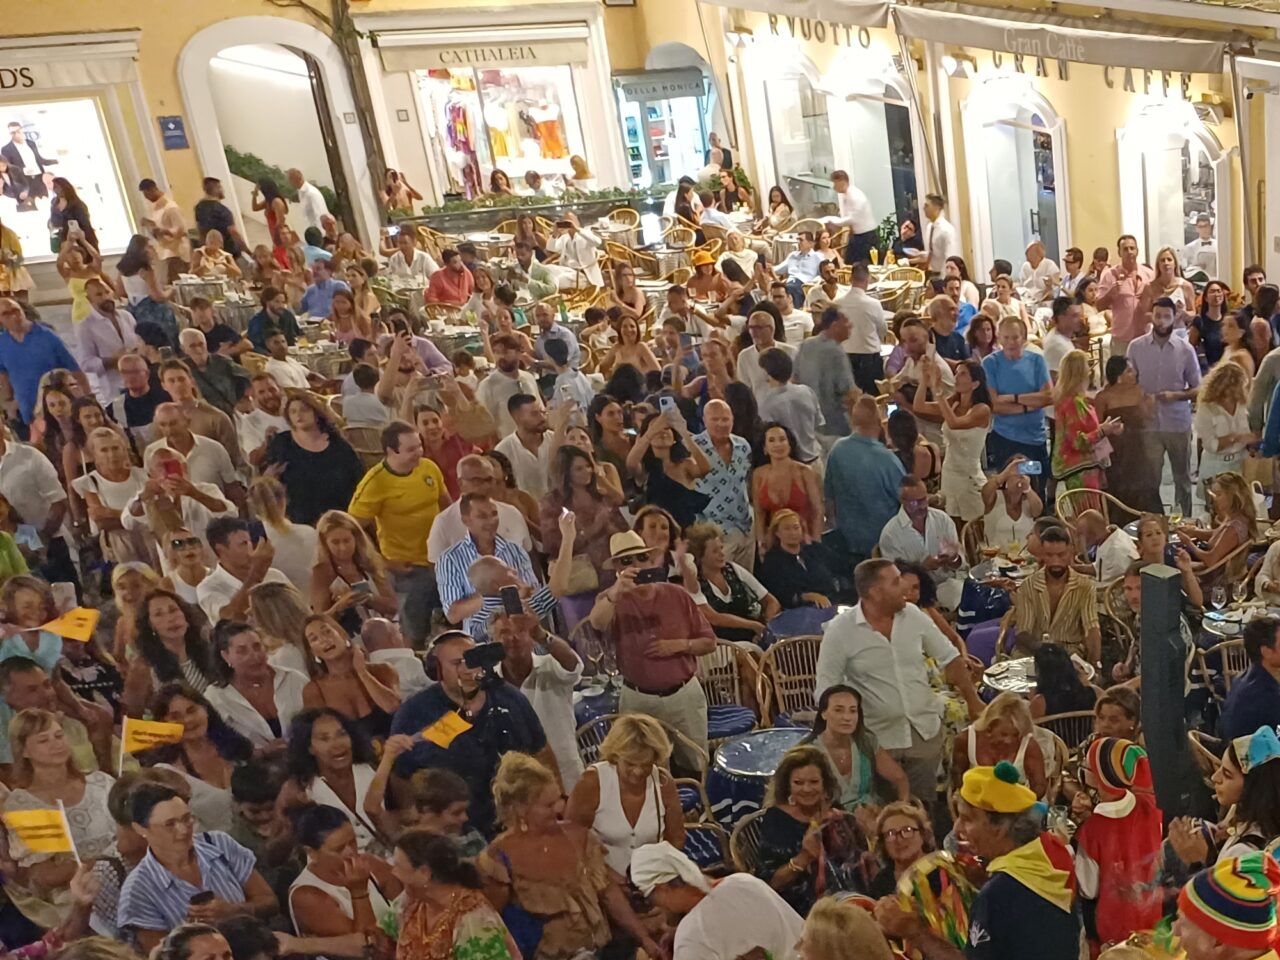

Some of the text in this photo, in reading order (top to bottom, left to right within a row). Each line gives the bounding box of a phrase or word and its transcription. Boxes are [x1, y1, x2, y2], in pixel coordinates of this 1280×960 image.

[1004, 28, 1041, 55] Gran
[439, 46, 537, 63] CATHALEIA
[627, 81, 700, 96] DELLA MONICA
